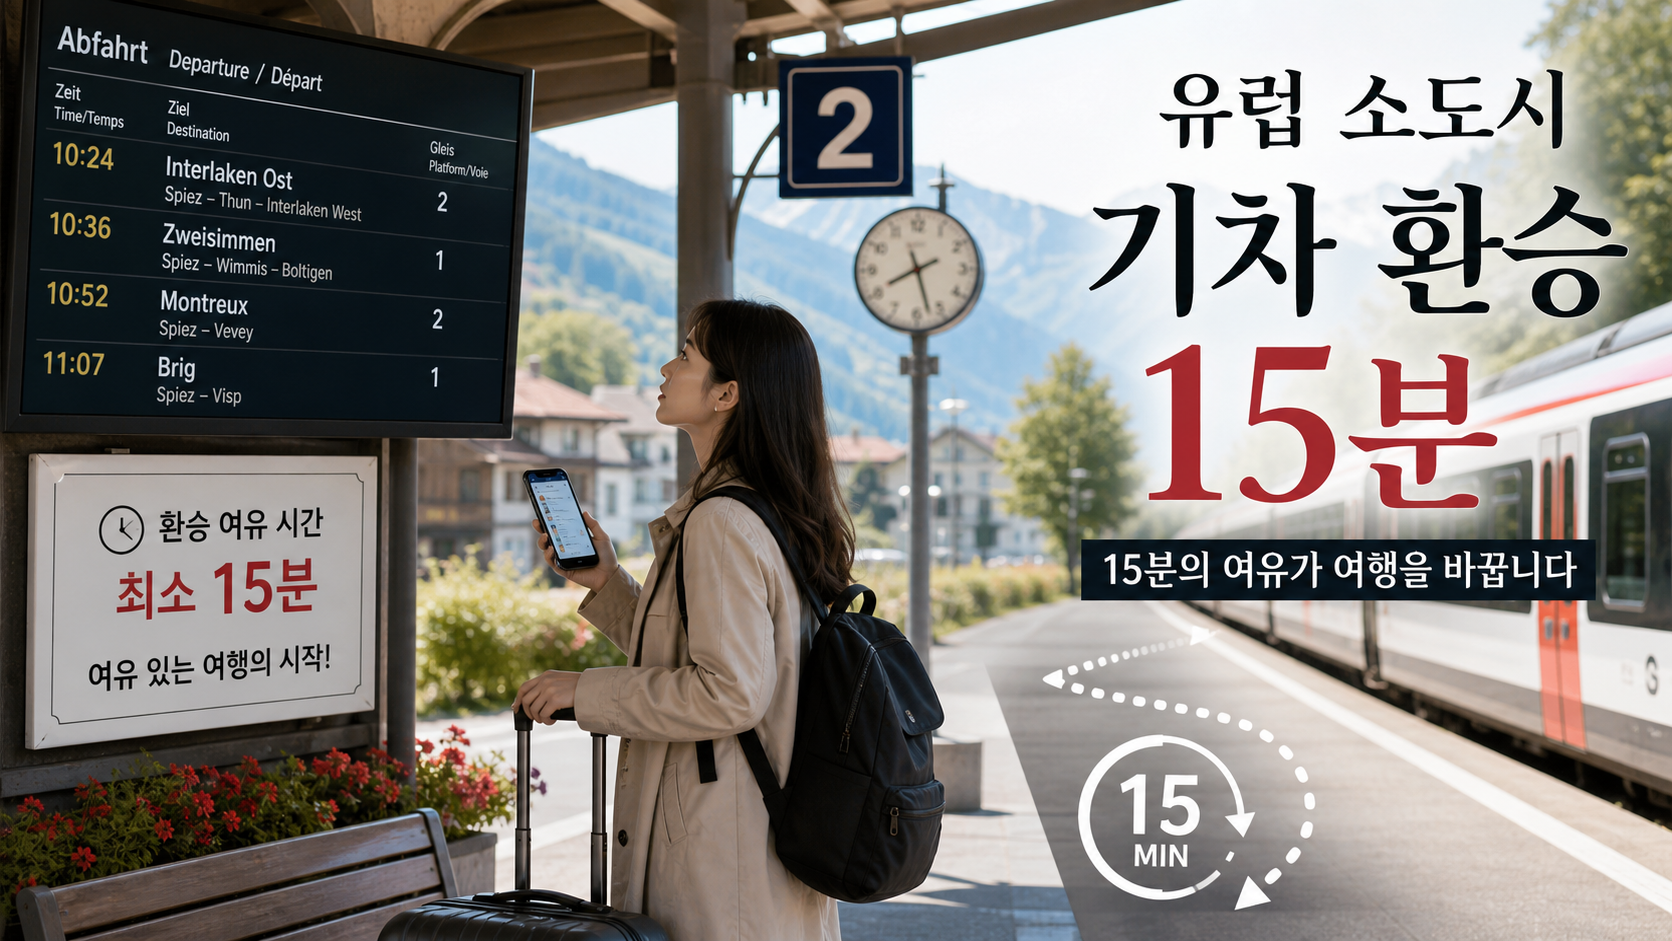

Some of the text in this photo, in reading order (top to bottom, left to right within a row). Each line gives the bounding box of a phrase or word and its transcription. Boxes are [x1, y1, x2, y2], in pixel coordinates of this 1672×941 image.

[56, 25, 149, 65] Abfahrt
[169, 48, 323, 93] Departure / Départ
[54, 82, 82, 102] Zeit
[53, 105, 125, 131] Time/Temps
[167, 99, 190, 117] Ziel
[166, 120, 230, 143] Destination
[817, 87, 873, 169] 2
[53, 141, 114, 171] 10:24
[429, 140, 455, 157] Gleis
[165, 155, 293, 191] Interlaken Ost
[428, 159, 489, 180] Platform/Voie
[164, 185, 203, 207] Spiez
[218, 191, 252, 211] Thun
[267, 196, 329, 218] Interlaken
[331, 204, 362, 222] West
[436, 191, 448, 213] 2
[50, 211, 111, 240] 10:36
[162, 222, 277, 254] Zweisimmen
[161, 252, 200, 274] Spiez
[216, 256, 268, 276] Wimmis
[282, 262, 333, 283] Boltigen
[435, 249, 444, 271] 1
[47, 281, 109, 308] 10:52
[160, 289, 249, 316] Montreux
[159, 319, 198, 340] Spiez
[214, 322, 254, 344] Vevey
[432, 308, 443, 330] 2
[43, 350, 105, 376] 11:07
[157, 355, 196, 384] Brig
[430, 366, 439, 388] 1
[156, 385, 195, 407] Spiez
[212, 387, 242, 408] Visp
[158, 506, 324, 543] 환승 여유 시간
[116, 557, 318, 621] 최소 15분
[88, 643, 330, 692] 여유 있는 여행의 시작!
